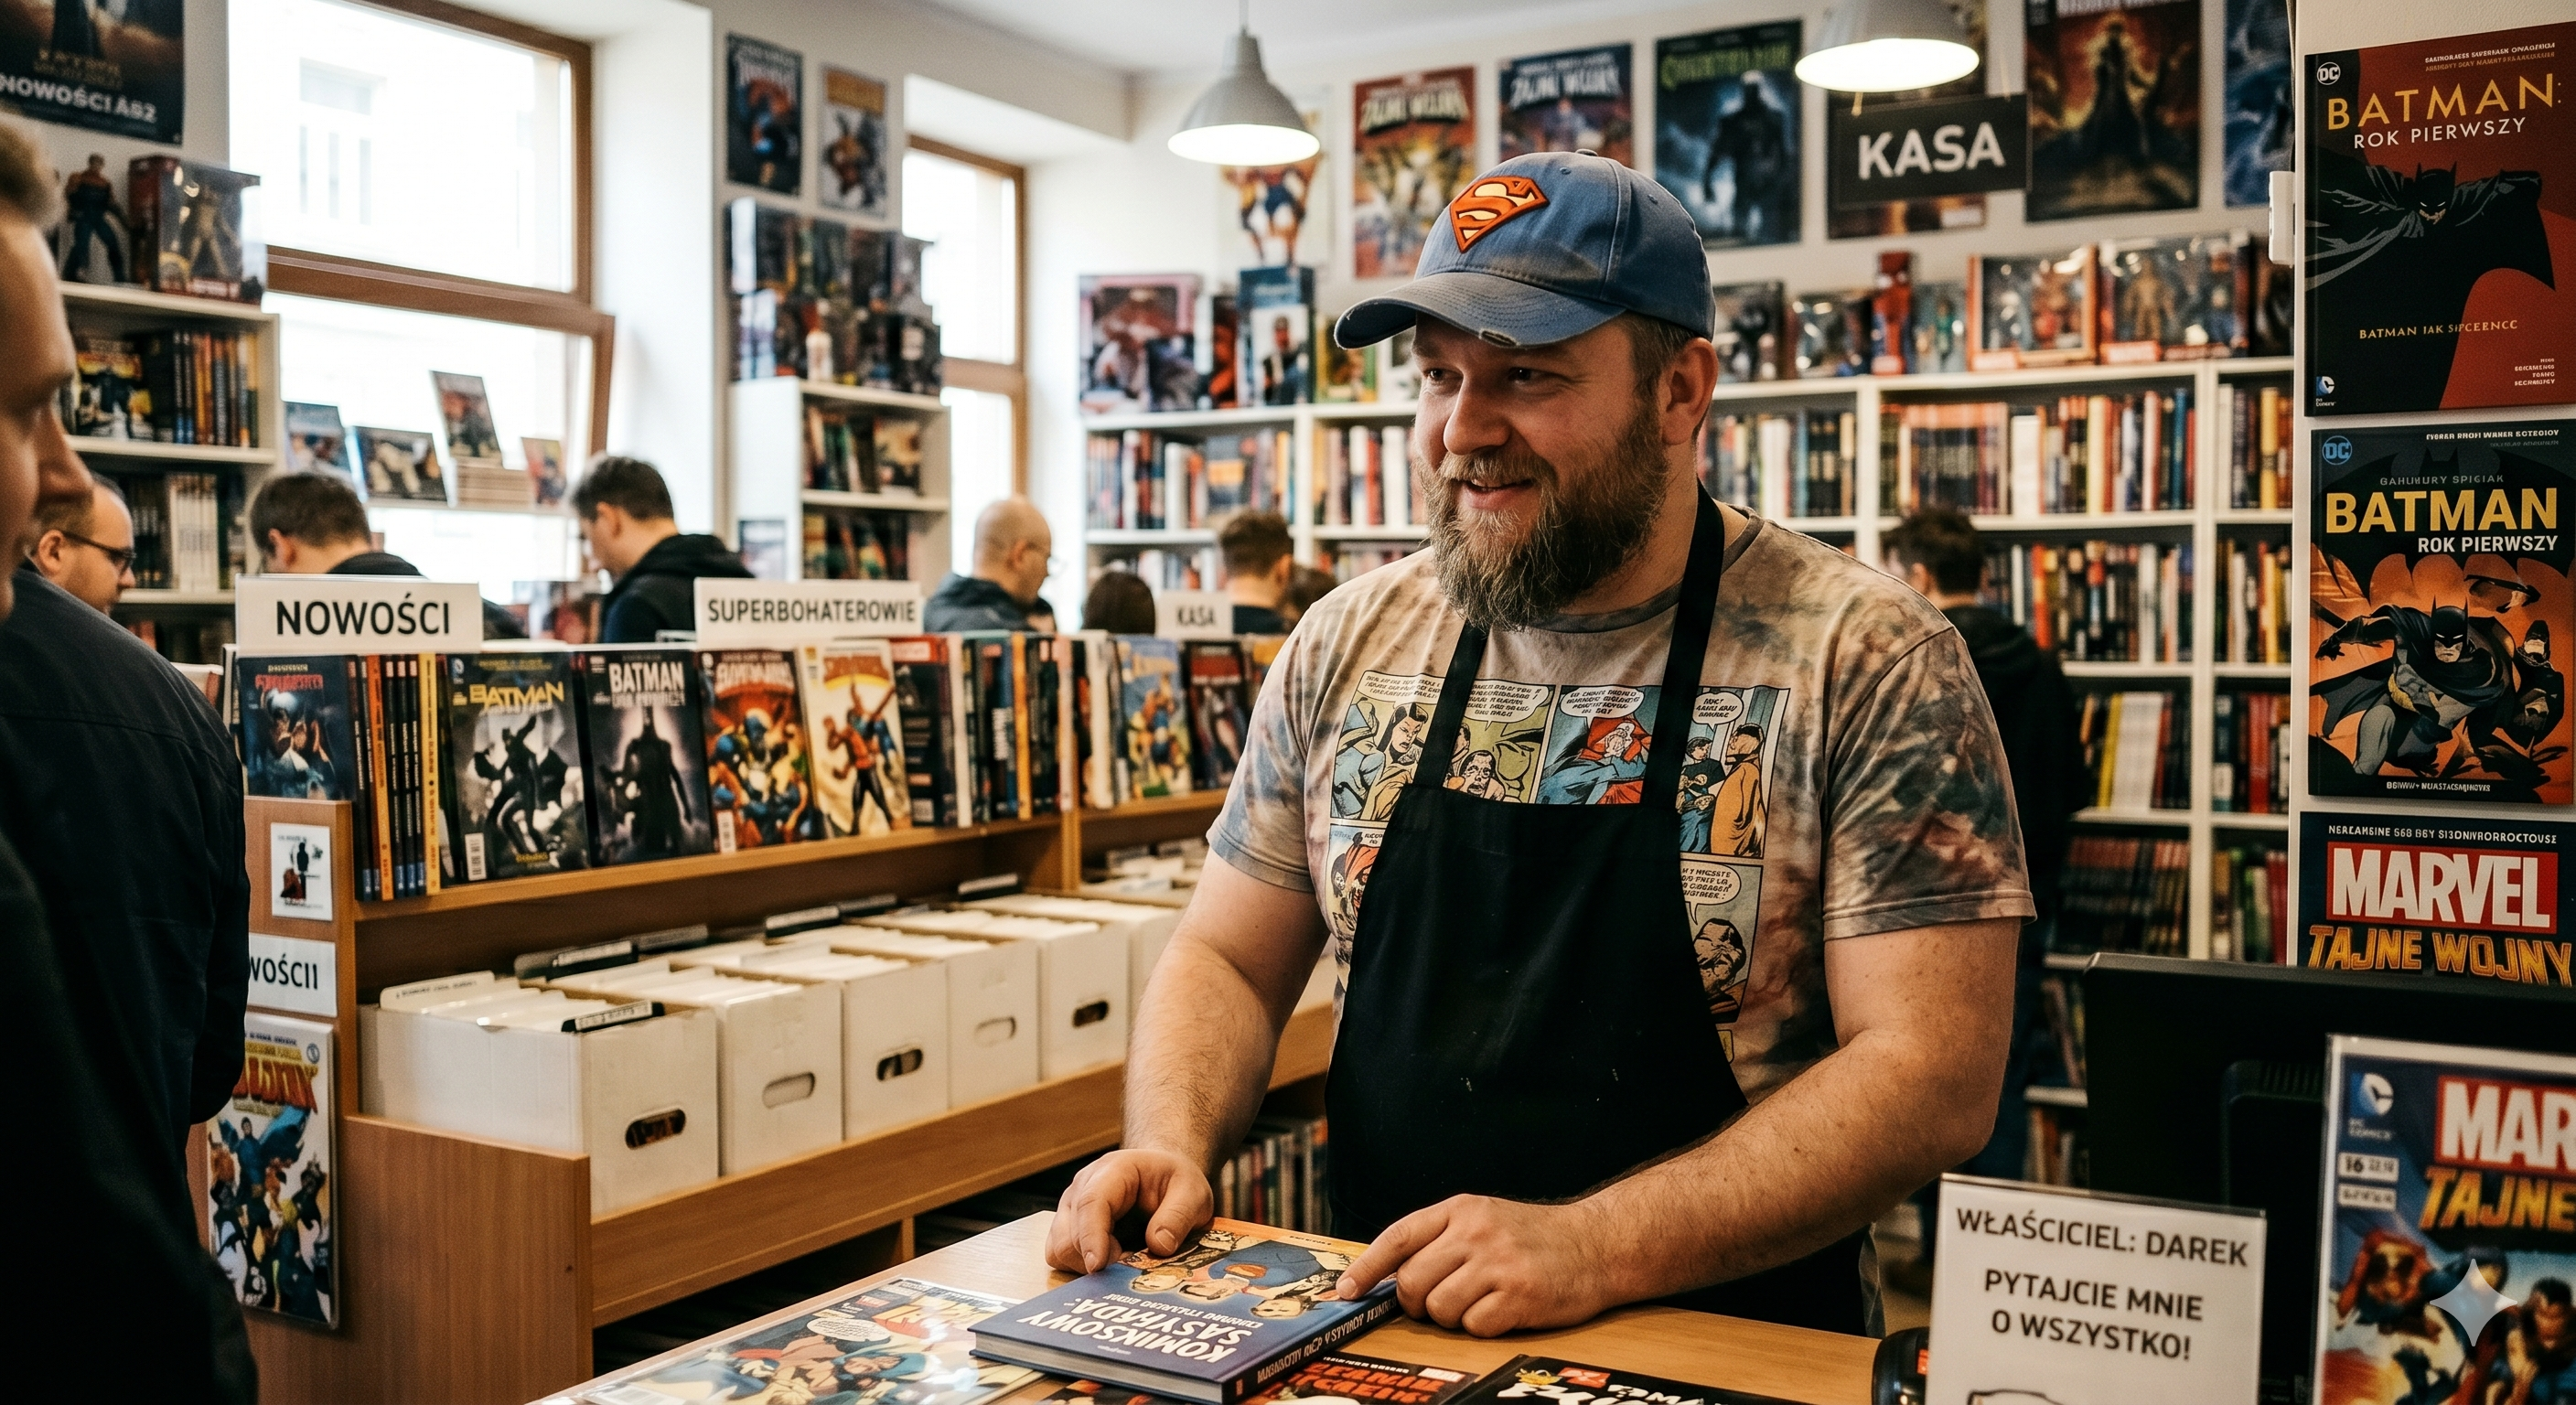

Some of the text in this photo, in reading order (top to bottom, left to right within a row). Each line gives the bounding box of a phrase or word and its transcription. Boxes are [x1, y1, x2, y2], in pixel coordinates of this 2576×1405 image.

[2318, 67, 2339, 80] DC
[1858, 122, 2006, 180] KASA
[2354, 117, 2526, 149] ROK PIERWSZY
[2359, 326, 2417, 339] BATMAN
[2324, 442, 2351, 459] DC
[2325, 487, 2558, 534] BATMAN
[2418, 535, 2559, 553] ROK PIERWSZY
[276, 591, 449, 636] NOWOŚCI
[708, 598, 916, 623] SUPERBOHATEROWIE
[469, 681, 564, 707] BATMAN
[609, 661, 684, 693] BATMAN
[2333, 847, 2550, 928] MARVEL
[2308, 924, 2572, 987] TAJNE WOJNY
[2418, 1165, 2576, 1232] TAJNE
[1957, 1208, 2249, 1268] WŁAŚCICIEL: DAREK
[1985, 1269, 2205, 1322] PYTAJCIE MNIE
[1991, 1310, 2191, 1360] O WSZYSTKO!
